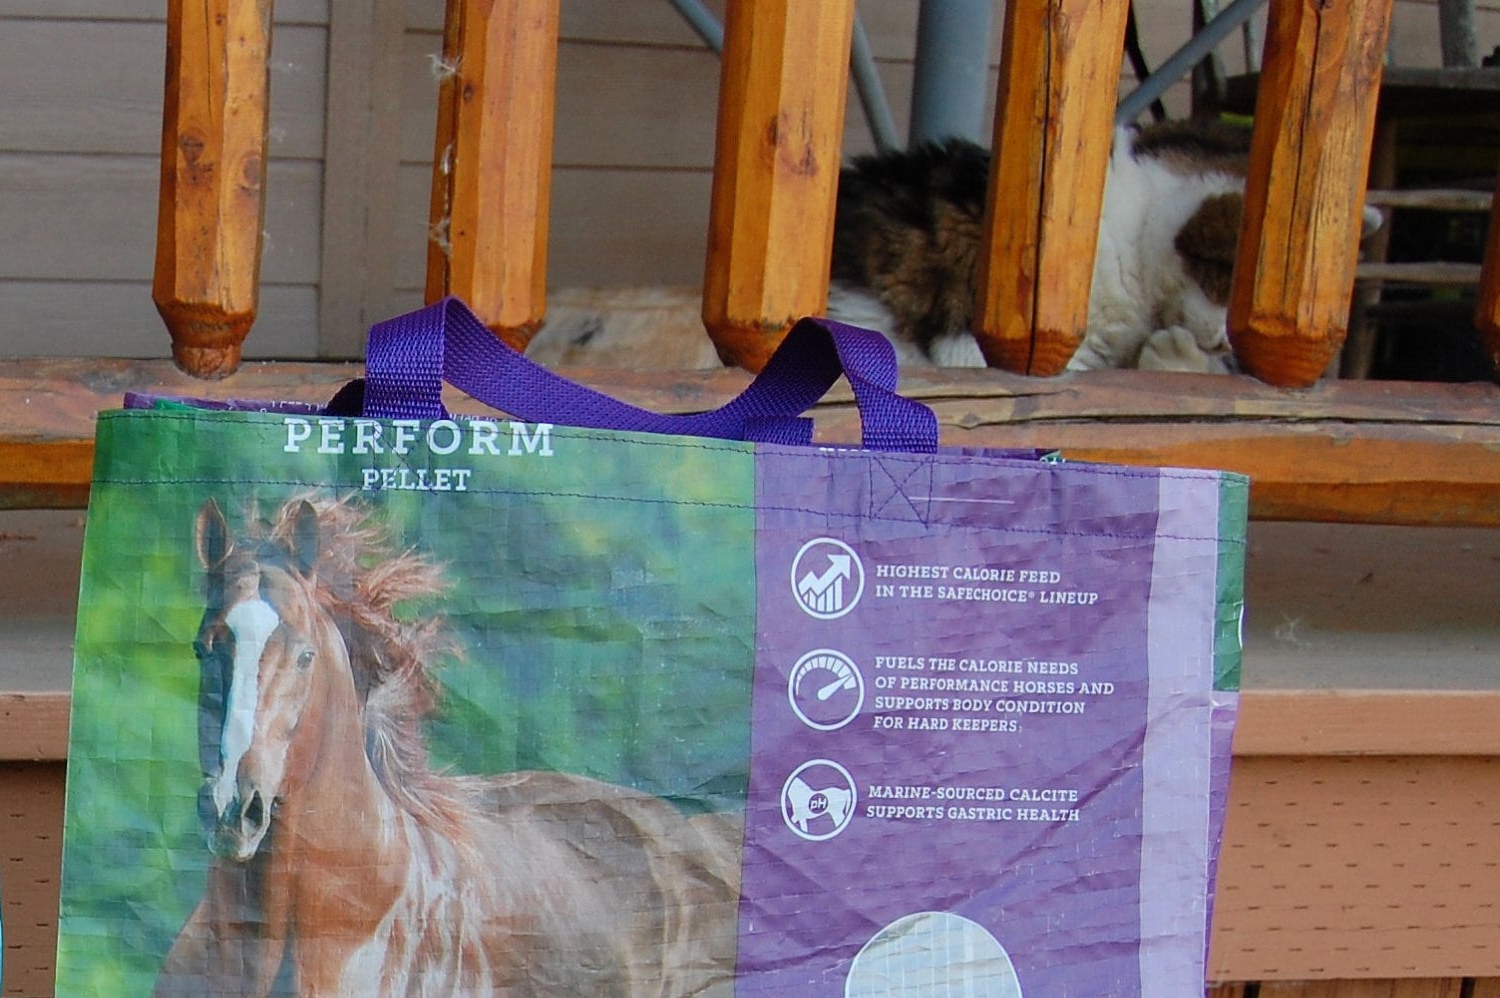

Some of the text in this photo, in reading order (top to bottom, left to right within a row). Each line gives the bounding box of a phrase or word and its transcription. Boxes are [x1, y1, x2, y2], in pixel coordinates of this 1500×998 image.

[283, 417, 554, 456] PERFORM
[362, 468, 471, 491] PELLET
[876, 565, 1061, 584] HIGHEST CALORIE FEED
[875, 586, 894, 597] IN
[900, 586, 933, 598] THE
[1039, 590, 1098, 605] LINEUP
[875, 656, 1079, 675] FUELS THE CALORIE NEEDS
[875, 677, 1114, 695] OF PERFORMANCE HORSES AND
[875, 696, 1085, 715] SUPPORTS BODY CONDITION
[873, 716, 903, 729] FOR
[907, 717, 949, 730] HARD
[868, 785, 1078, 802] MARINE-SOURCED CALCITE
[866, 806, 1080, 822] SUPPORTS GASTRIC HEALTH
